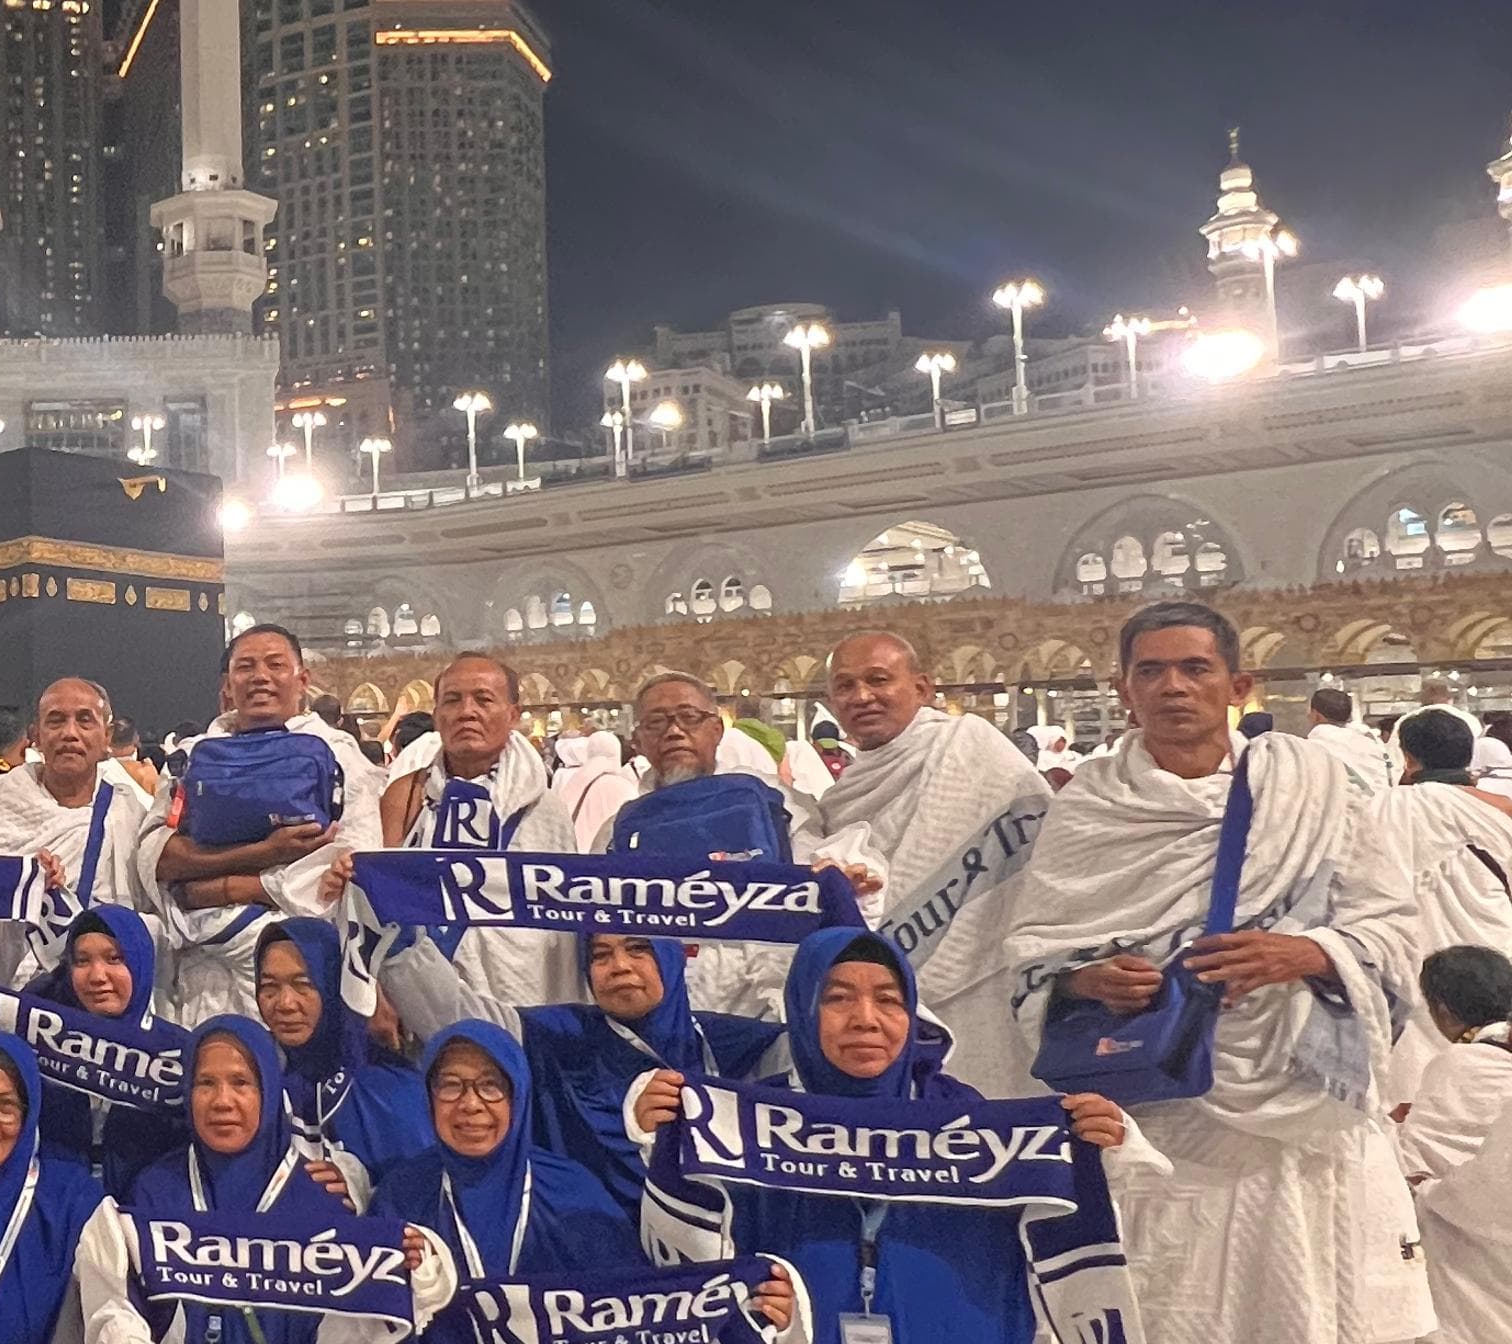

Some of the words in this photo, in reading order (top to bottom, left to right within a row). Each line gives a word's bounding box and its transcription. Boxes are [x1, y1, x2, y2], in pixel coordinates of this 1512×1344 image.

[521, 863, 823, 927] Raméyza
[525, 904, 586, 922] Tour
[594, 909, 611, 924] &
[616, 909, 696, 927] Travel
[26, 1007, 184, 1104] Ramé
[35, 1049, 71, 1073] our
[76, 1065, 89, 1081] &
[96, 1069, 160, 1102] Travel
[760, 1152, 830, 1178] Tour
[838, 1161, 858, 1179] &
[864, 1161, 960, 1185] Travel
[156, 1266, 213, 1286] Tour
[221, 1273, 239, 1289] &
[245, 1272, 323, 1296] Travel
